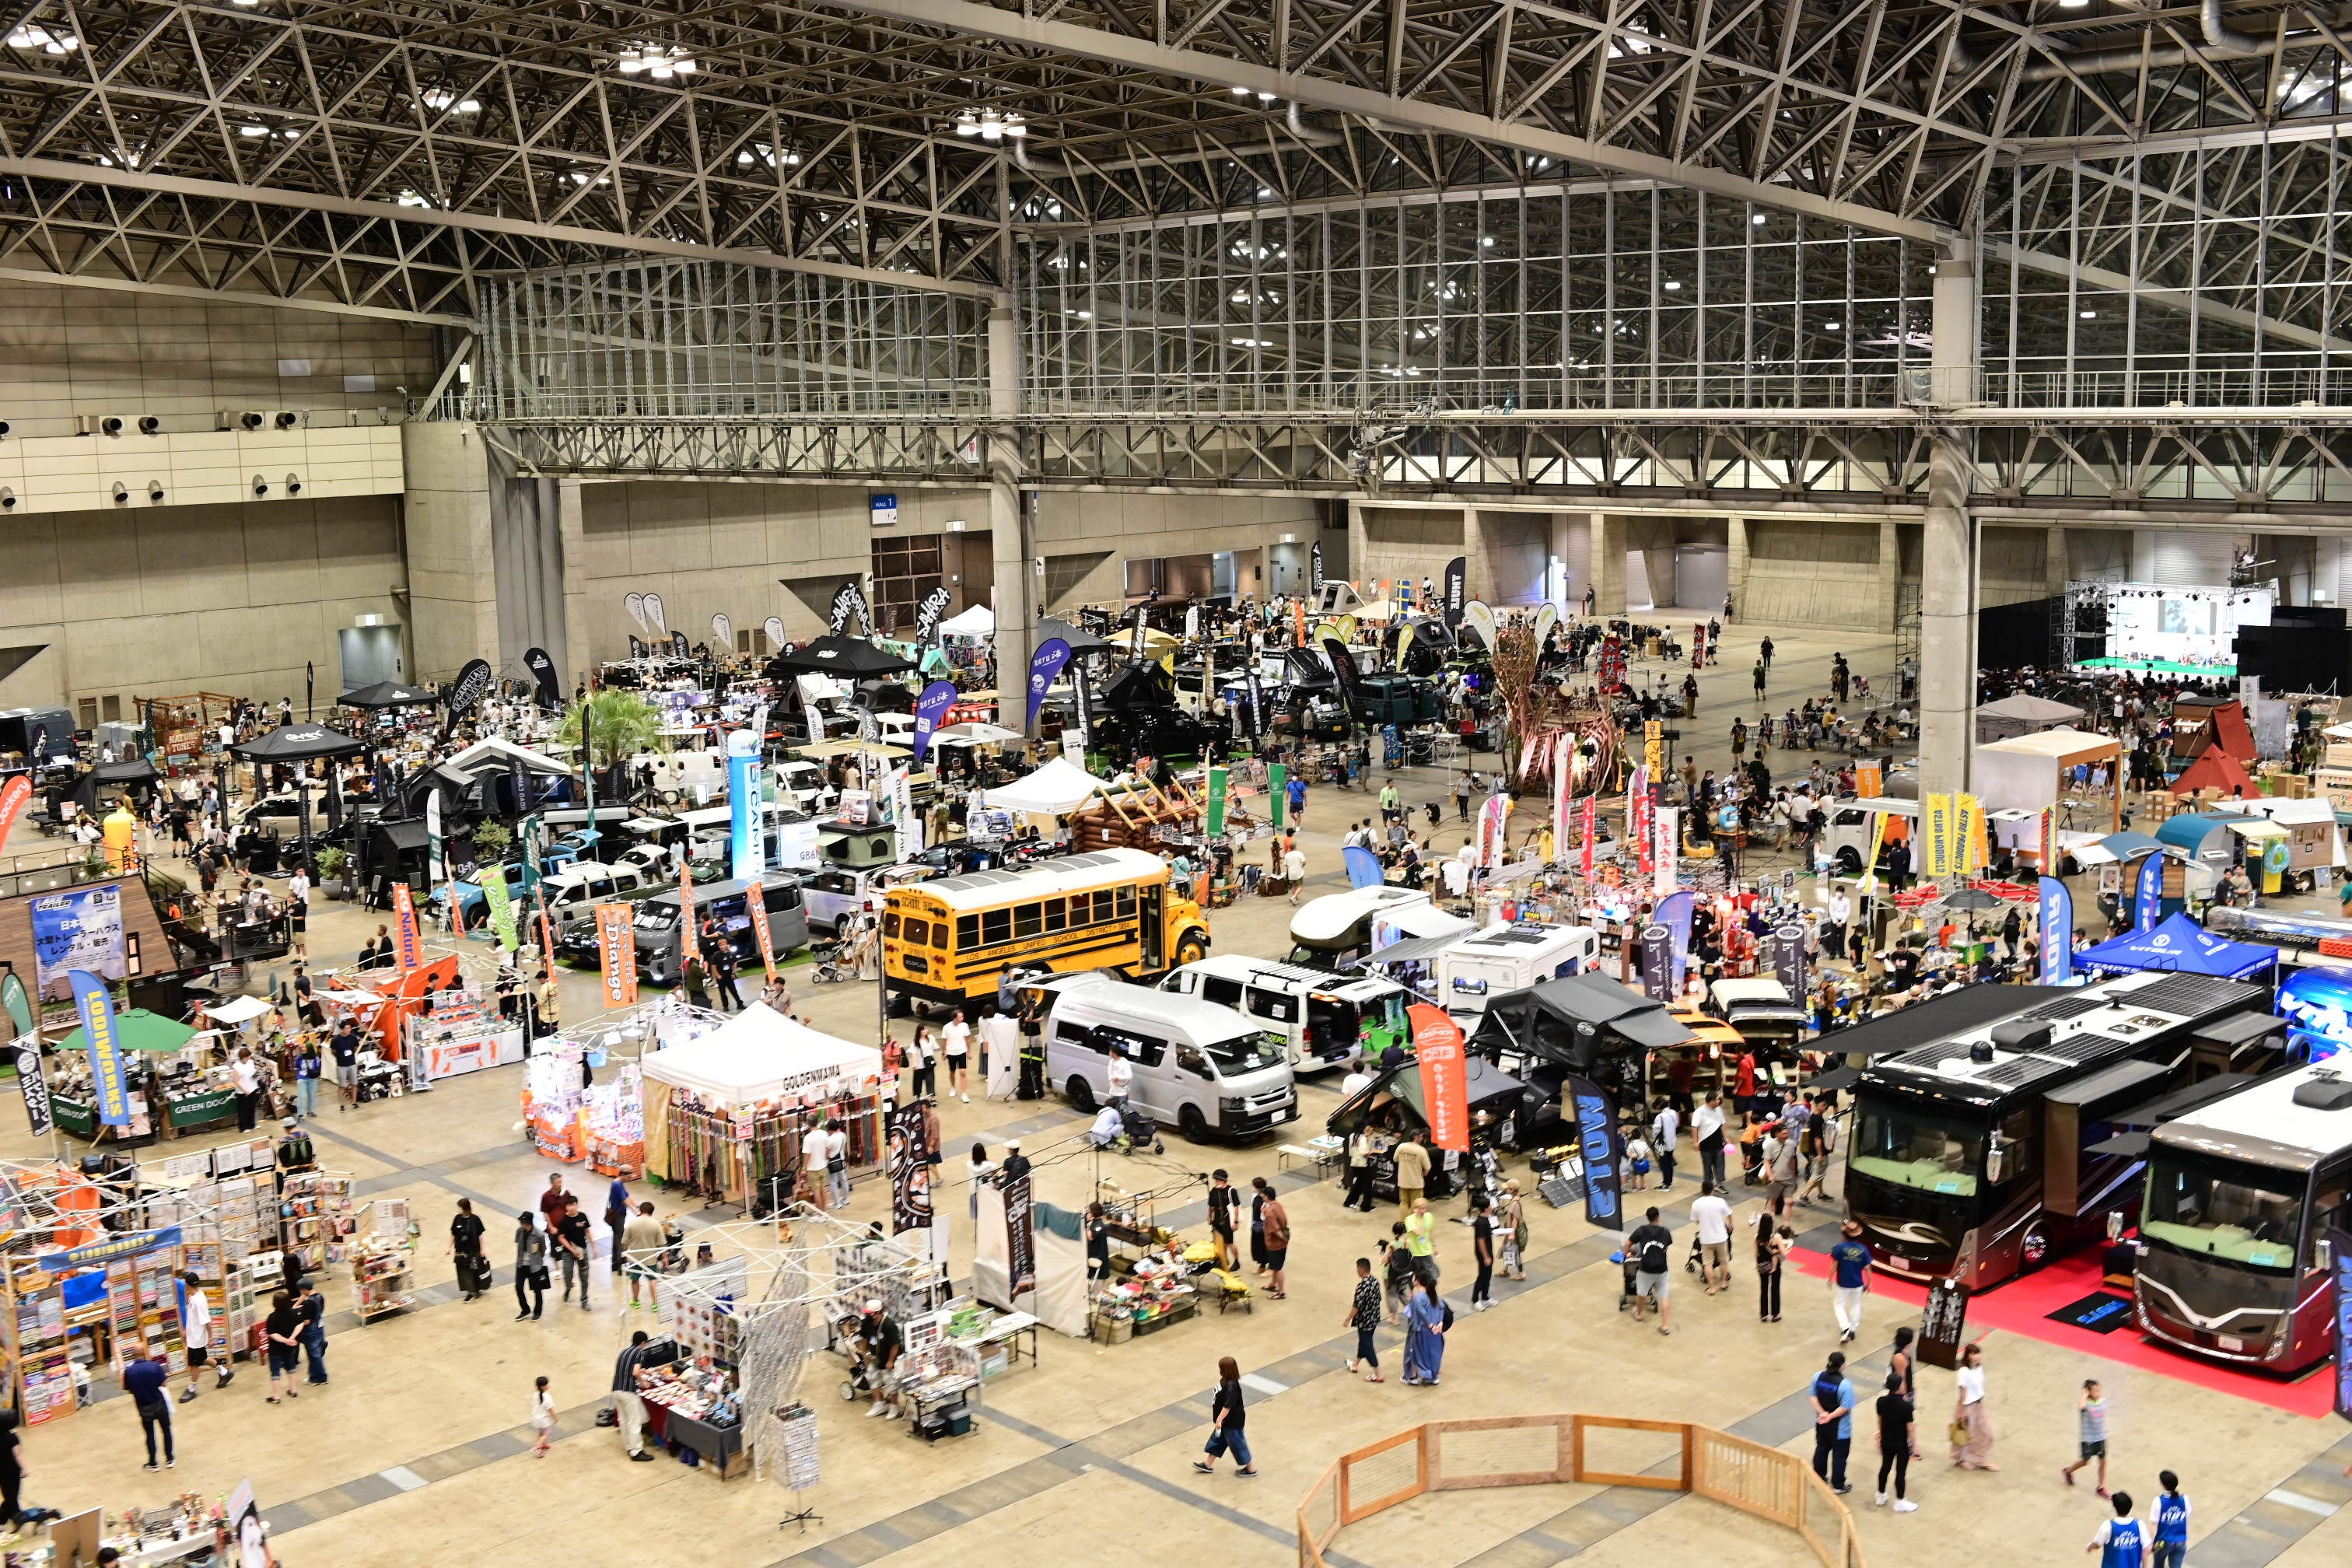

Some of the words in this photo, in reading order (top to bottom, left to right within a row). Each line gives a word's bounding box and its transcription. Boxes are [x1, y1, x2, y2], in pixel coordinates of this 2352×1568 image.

[888, 499, 893, 507] 1
[916, 587, 950, 638] SAHARA
[1034, 655, 1050, 667] neru
[920, 698, 936, 709] neru
[169, 731, 199, 743] NATURE
[172, 742, 197, 752] TONES
[1959, 808, 1970, 833] ASTRO
[1953, 834, 1968, 870] PRODUCTS
[37, 900, 72, 911] TRAILER
[397, 889, 409, 912] K9
[901, 897, 921, 910] SCHOOL
[922, 901, 933, 912] BUS
[37, 923, 120, 946] 大型トレーラーハウス
[401, 912, 418, 968] Natural
[966, 953, 979, 961] LOS
[987, 945, 1016, 957] ANGELES
[1023, 939, 1046, 950] UNIFIED
[1053, 933, 1080, 943] SCHOOL
[1086, 926, 1114, 937] DISTRICT
[2130, 945, 2182, 956] VITOUR
[2085, 961, 2141, 975] TEMPES
[1269, 1033, 1286, 1045] ZERO
[87, 990, 123, 1118] LODIWORKS
[783, 1065, 840, 1091] GOLDENMAMA
[174, 1103, 206, 1115] GREEN
[206, 1098, 226, 1108] DOG
[2160, 1510, 2186, 1523] STAFF
[2113, 1535, 2140, 1548] STAFF
